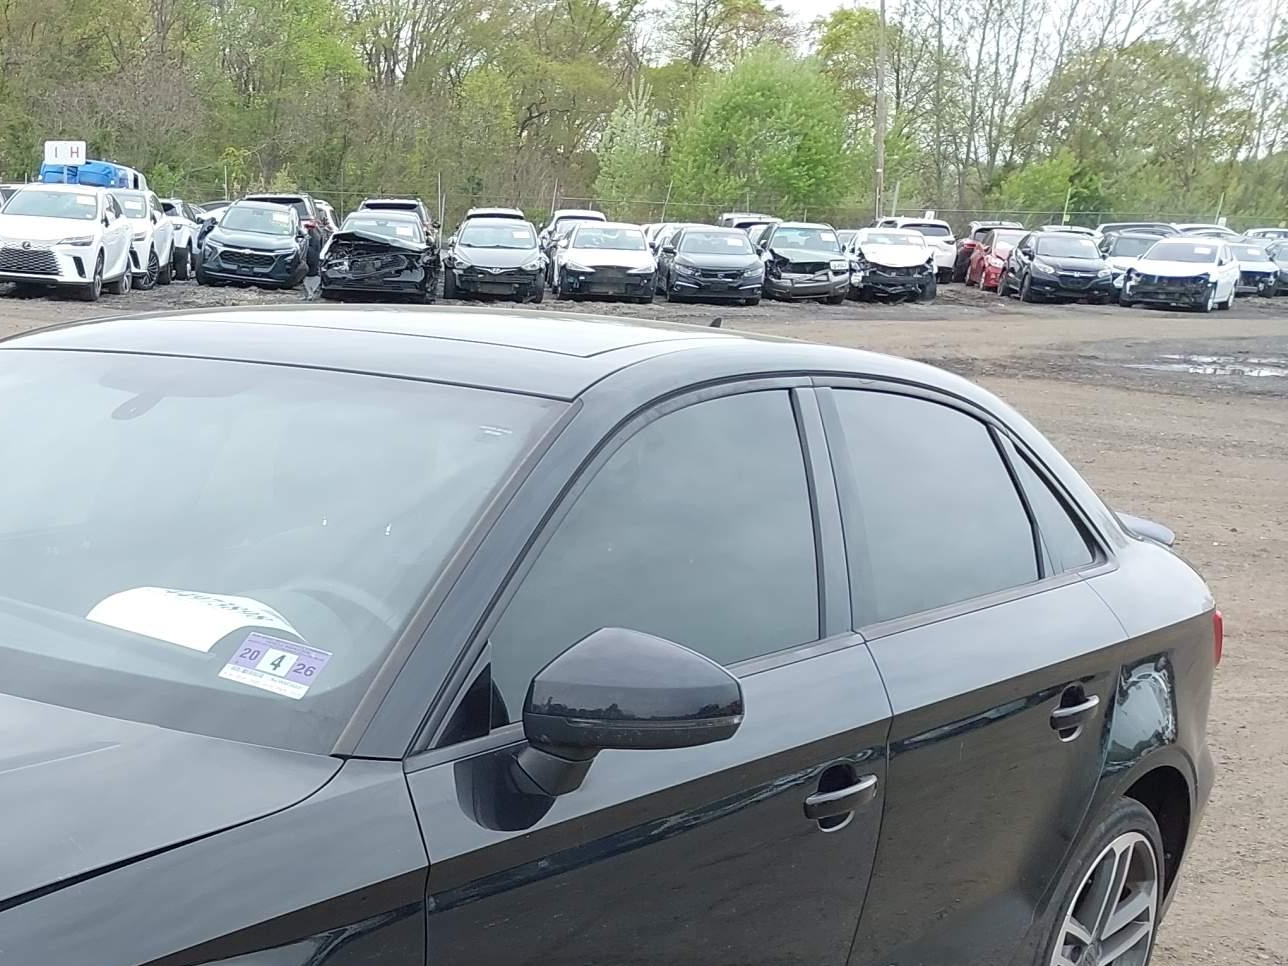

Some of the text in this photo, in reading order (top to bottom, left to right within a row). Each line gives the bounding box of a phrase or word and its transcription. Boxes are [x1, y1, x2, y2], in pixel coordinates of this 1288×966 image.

[70, 146, 79, 158] H
[239, 647, 261, 661] 20
[270, 654, 287, 671] 4
[293, 663, 317, 677] 26
